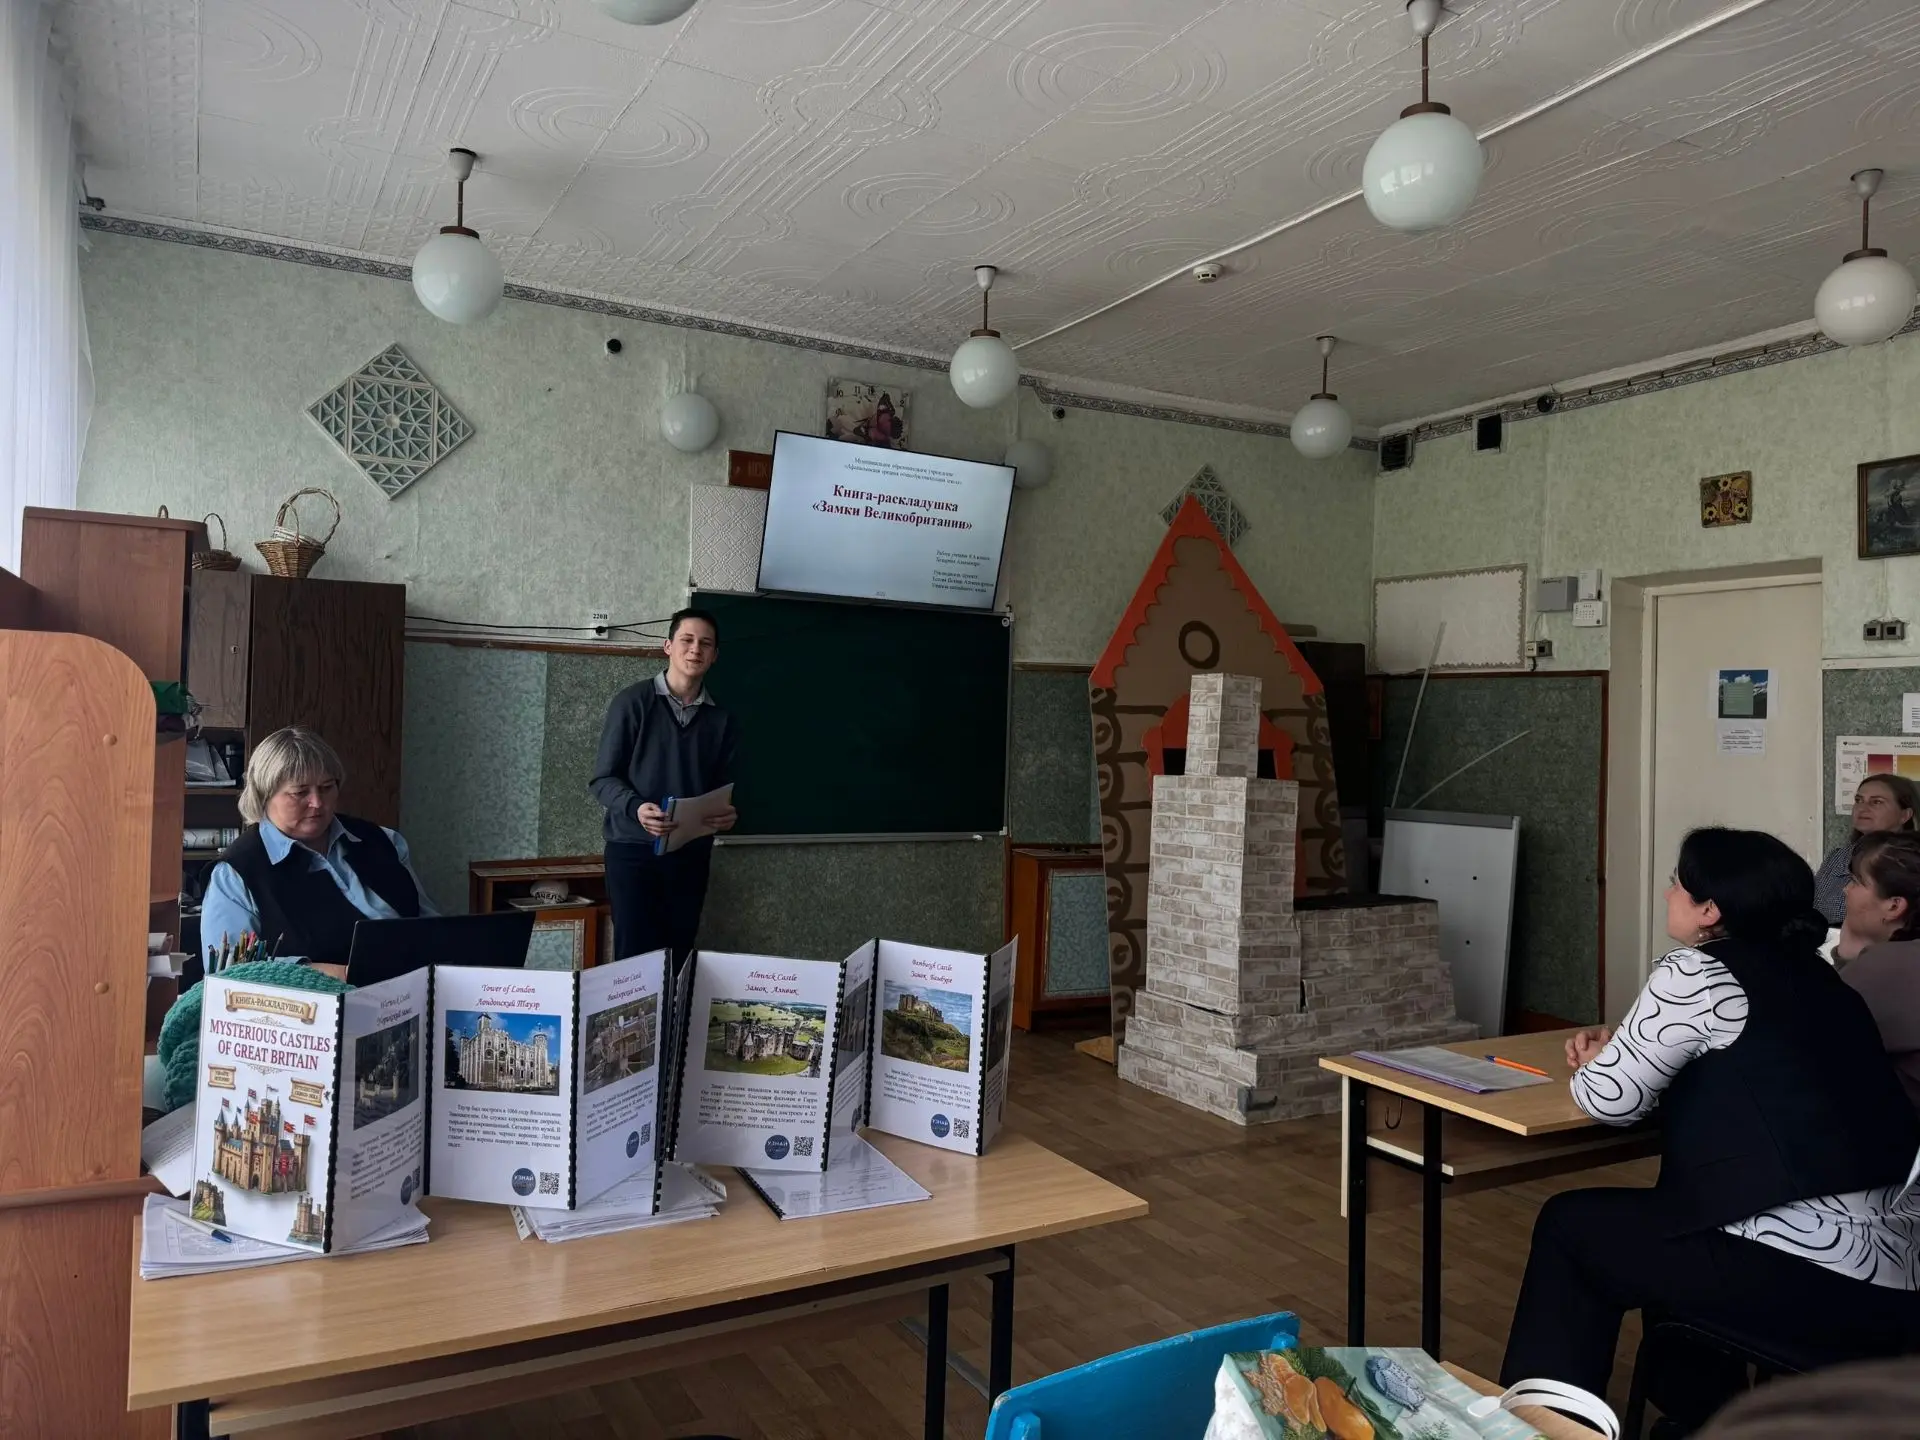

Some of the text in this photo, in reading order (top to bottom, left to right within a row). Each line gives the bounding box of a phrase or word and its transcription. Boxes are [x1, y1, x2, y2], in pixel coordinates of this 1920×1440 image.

[833, 484, 958, 513] Книга-раскладушка
[812, 499, 973, 531] «Замки Великобритании»
[747, 970, 798, 982] Alnwick Castle
[481, 983, 536, 995] Tower of London
[744, 983, 800, 996] Замок Алнвик
[235, 996, 305, 1015] КНИГА-РАСКЛАДУШКА
[476, 997, 541, 1011] Лондонский Тауэр
[209, 1018, 331, 1052] MYSTERIOUS CASTLES
[218, 1039, 319, 1070] OF GREAT BRITAIN
